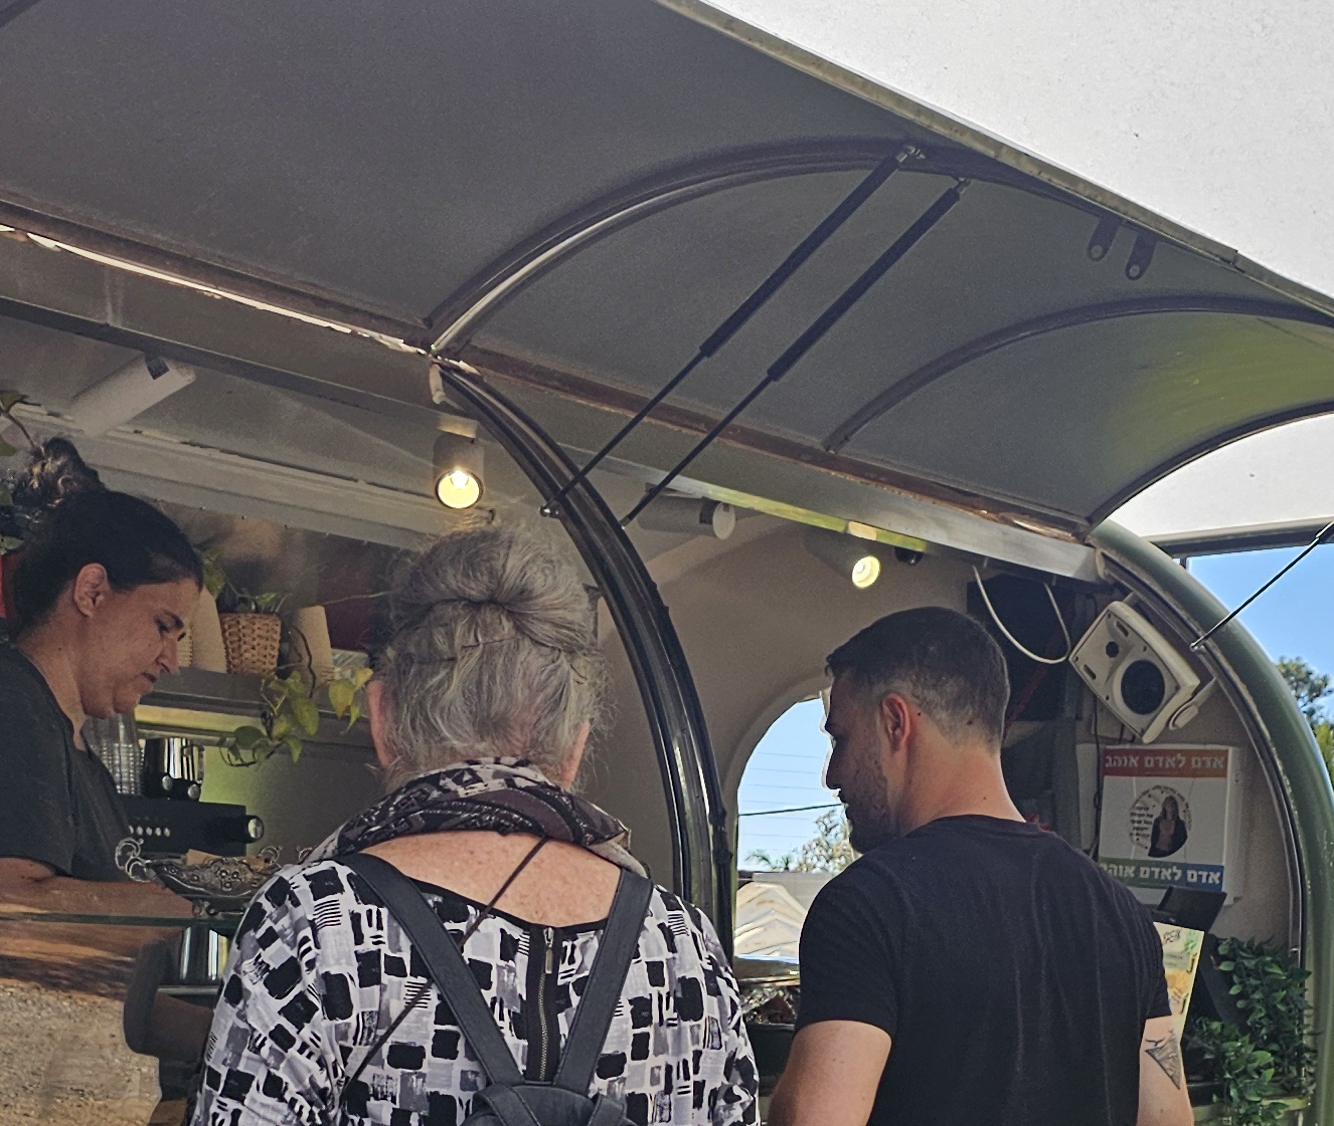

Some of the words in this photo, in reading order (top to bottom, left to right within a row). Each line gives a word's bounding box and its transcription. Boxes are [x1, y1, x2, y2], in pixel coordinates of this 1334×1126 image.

[1105, 756, 1139, 768] אוהב
[1144, 753, 1186, 769] לאדם
[1191, 756, 1225, 769] אדם
[1139, 866, 1182, 881] לאדם
[1187, 870, 1221, 885] אדם
